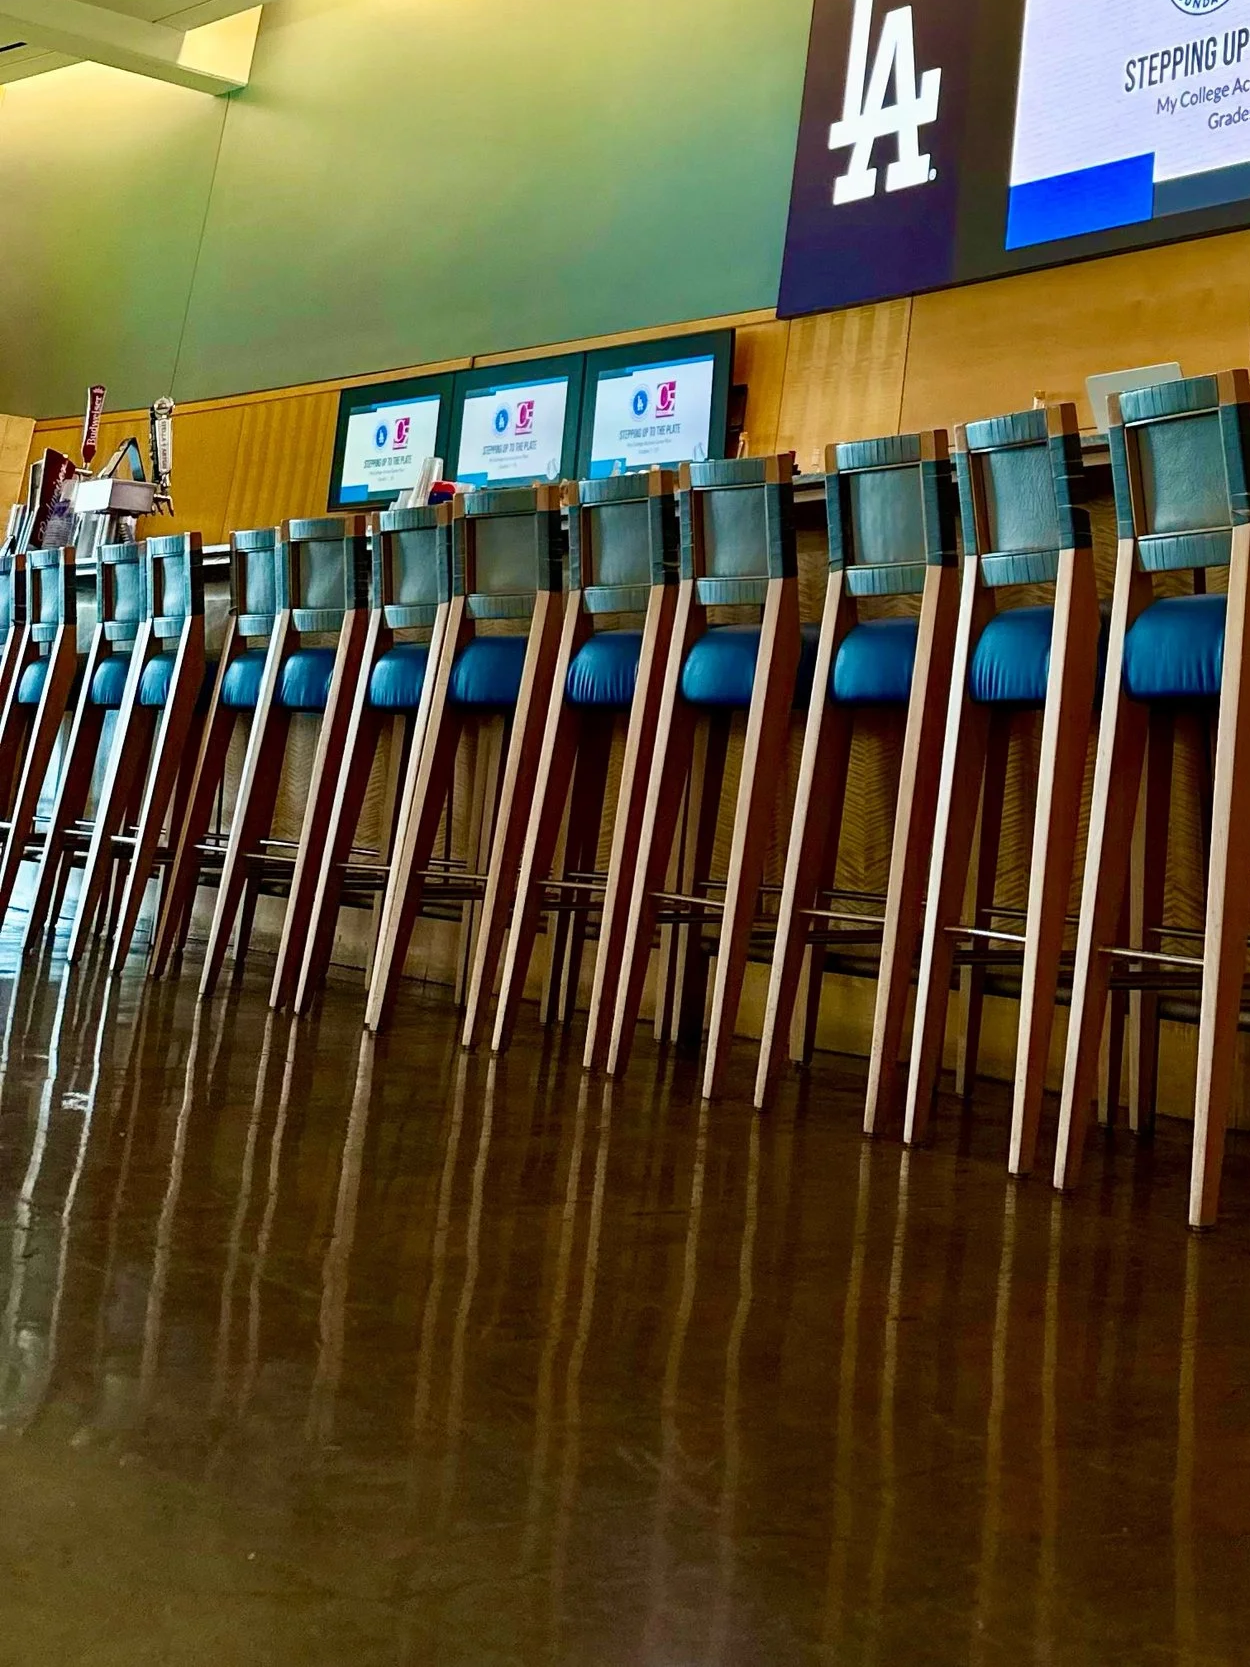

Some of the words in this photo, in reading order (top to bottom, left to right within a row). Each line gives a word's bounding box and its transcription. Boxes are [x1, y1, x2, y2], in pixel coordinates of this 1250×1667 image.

[1125, 36, 1217, 93] STEPPING
[1223, 27, 1250, 66] UP
[1156, 96, 1177, 115] My
[1180, 84, 1230, 108] College
[86, 395, 102, 445] Budweiser
